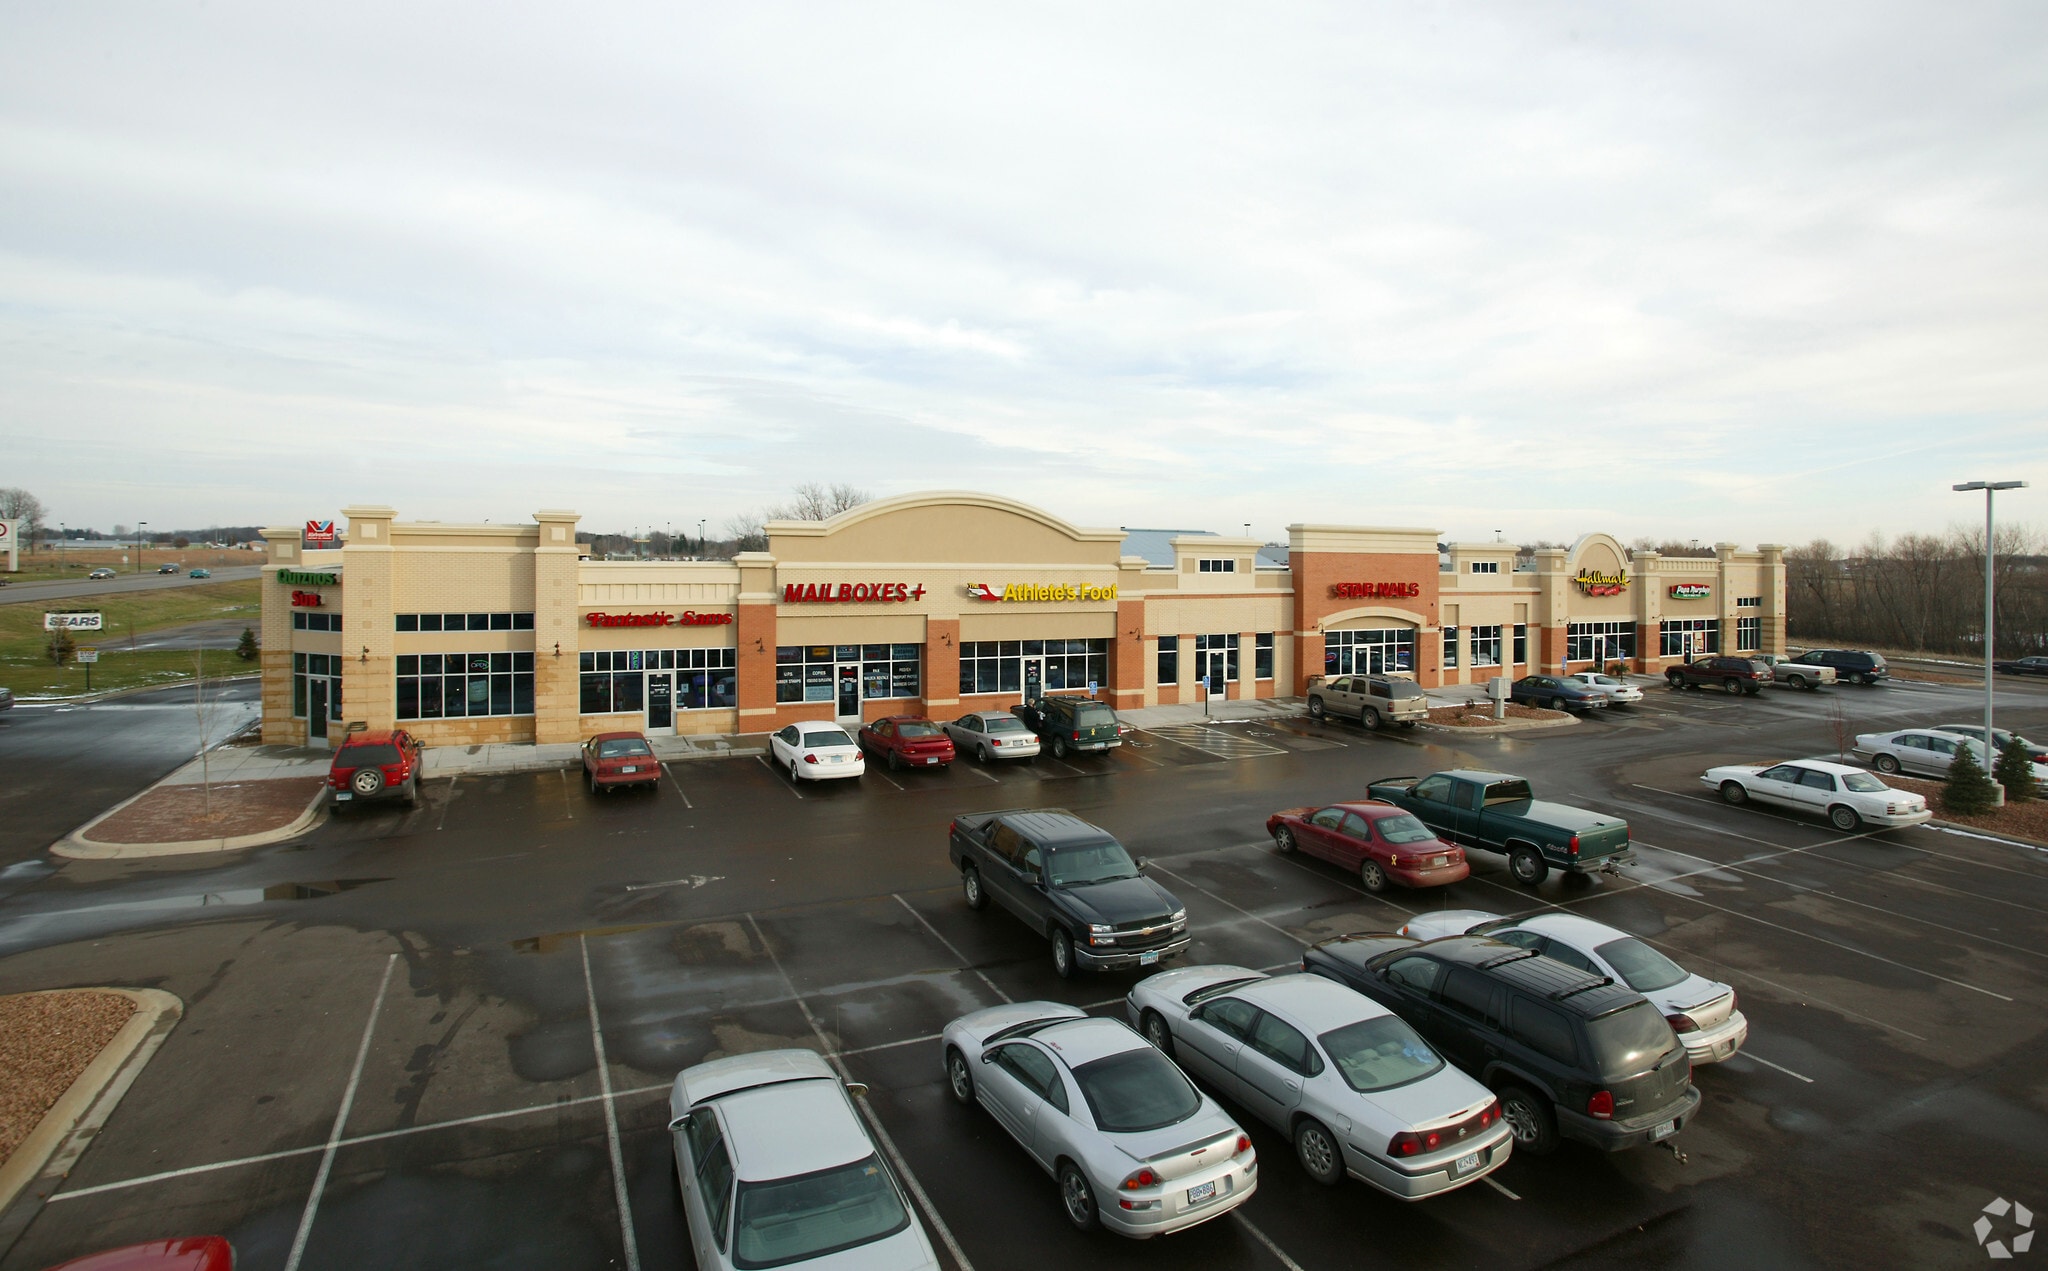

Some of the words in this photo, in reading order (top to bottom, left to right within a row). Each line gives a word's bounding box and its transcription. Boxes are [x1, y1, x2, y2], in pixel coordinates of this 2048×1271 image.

[1574, 568, 1631, 592] Hallmark
[1003, 582, 1076, 601] Athlete's
[1080, 582, 1117, 600] Foot
[1337, 582, 1374, 598] STAR
[1377, 582, 1419, 597] NAILS
[49, 616, 99, 626] SEARS
[586, 611, 674, 627] Fantastic
[680, 610, 733, 626] Sams
